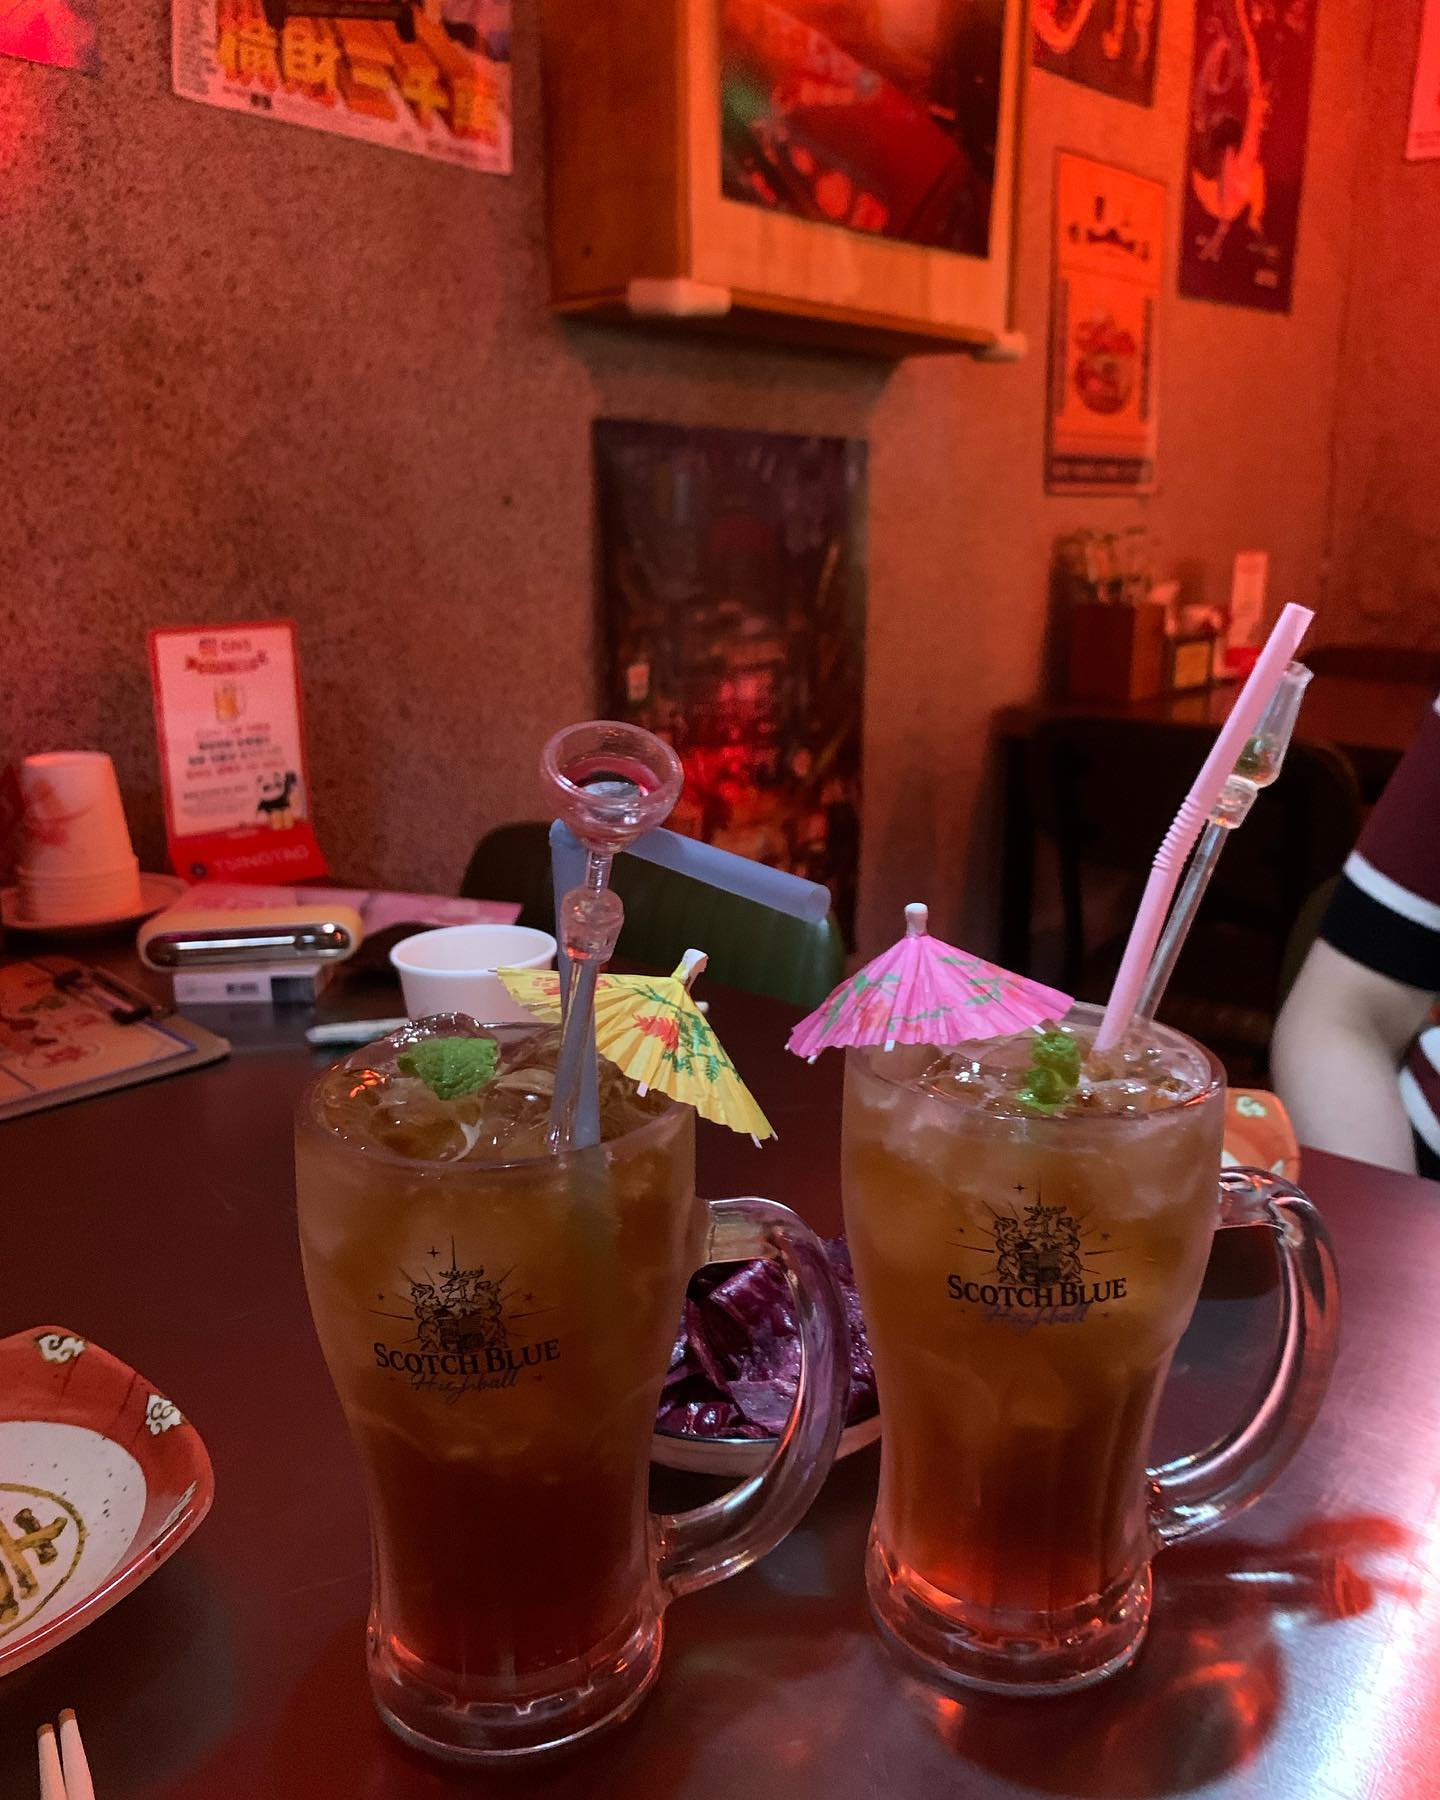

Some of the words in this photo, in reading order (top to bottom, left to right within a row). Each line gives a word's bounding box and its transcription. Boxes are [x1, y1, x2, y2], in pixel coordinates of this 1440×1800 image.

[947, 1274, 1054, 1308] SCOTCH
[1060, 1277, 1128, 1307] BLUE
[373, 1342, 483, 1376] SCOTCH
[485, 1338, 561, 1374] BLUE
